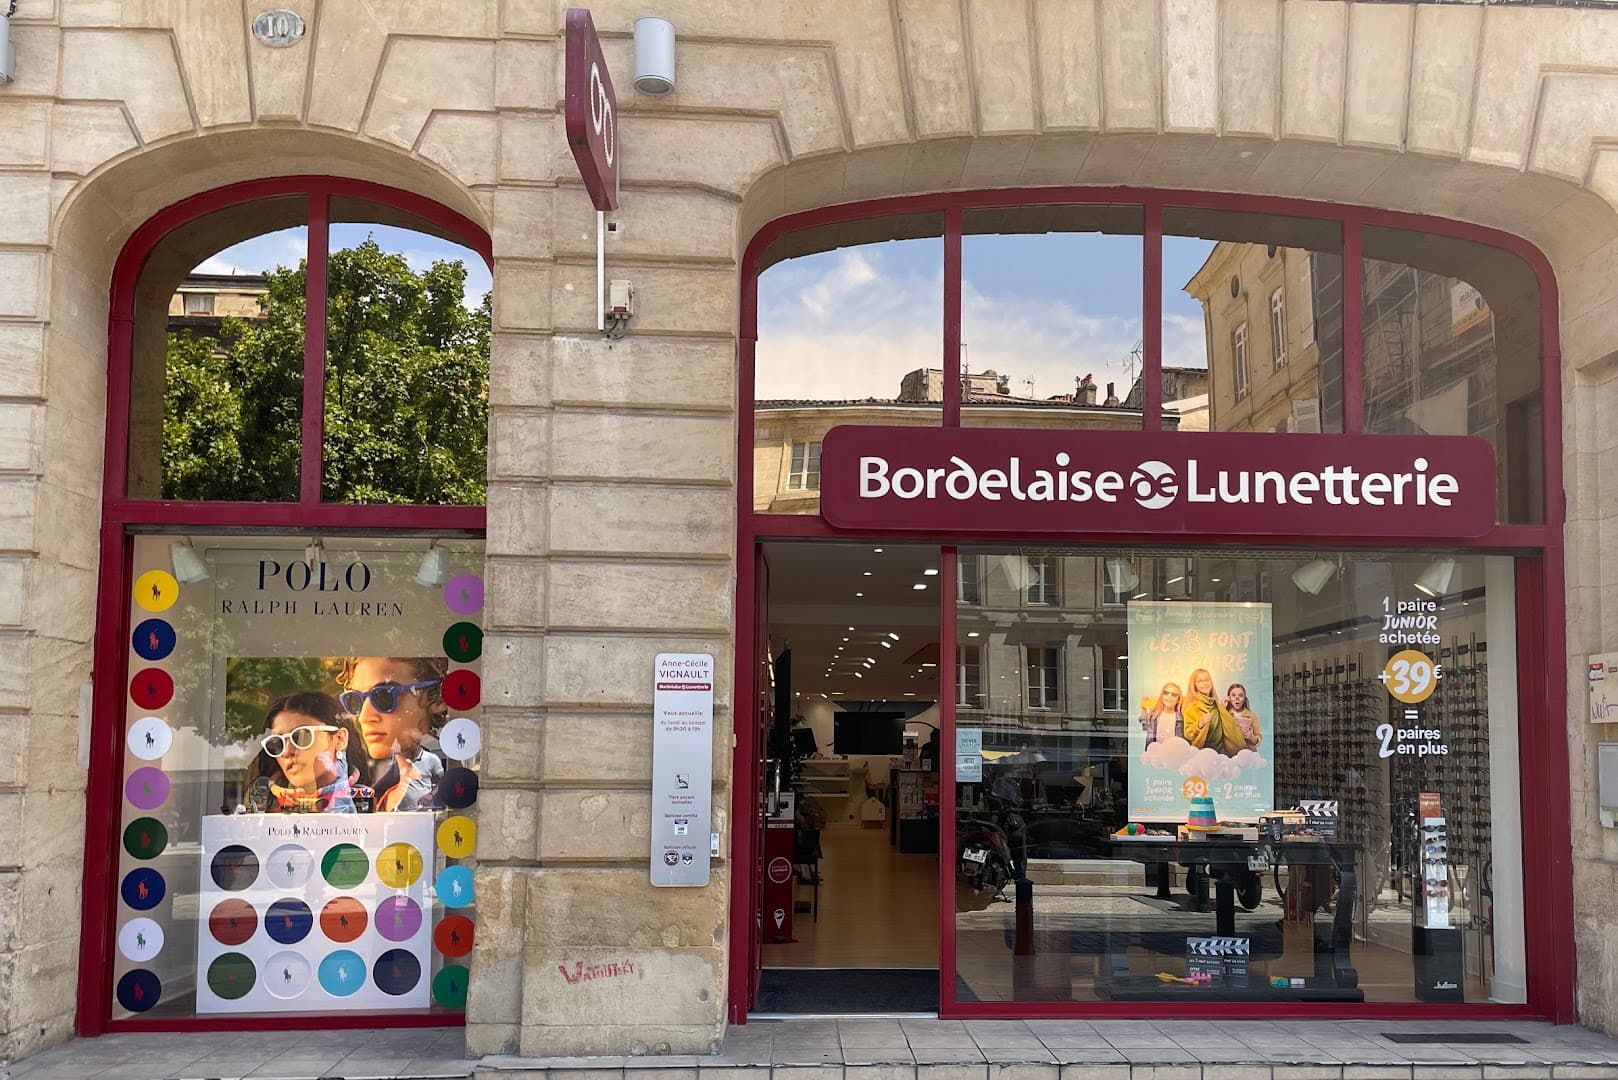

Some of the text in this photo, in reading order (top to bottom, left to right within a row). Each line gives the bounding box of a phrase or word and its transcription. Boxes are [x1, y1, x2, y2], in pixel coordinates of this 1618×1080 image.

[859, 452, 1459, 507] Bordelaise Lunetterie
[256, 560, 371, 593] POLO
[222, 600, 405, 616] RALPH LAUREN
[1382, 596, 1437, 614] 1 paire
[1382, 614, 1438, 630] JUNIOR
[1149, 626, 1254, 654] LES 3 FONT
[1379, 630, 1441, 644] achetée
[662, 659, 709, 668] Anne-Cécile
[659, 670, 709, 678] VIGNAULT
[1375, 723, 1441, 759] 2 paires
[1397, 741, 1449, 757] en plus
[1224, 782, 1233, 800] 2
